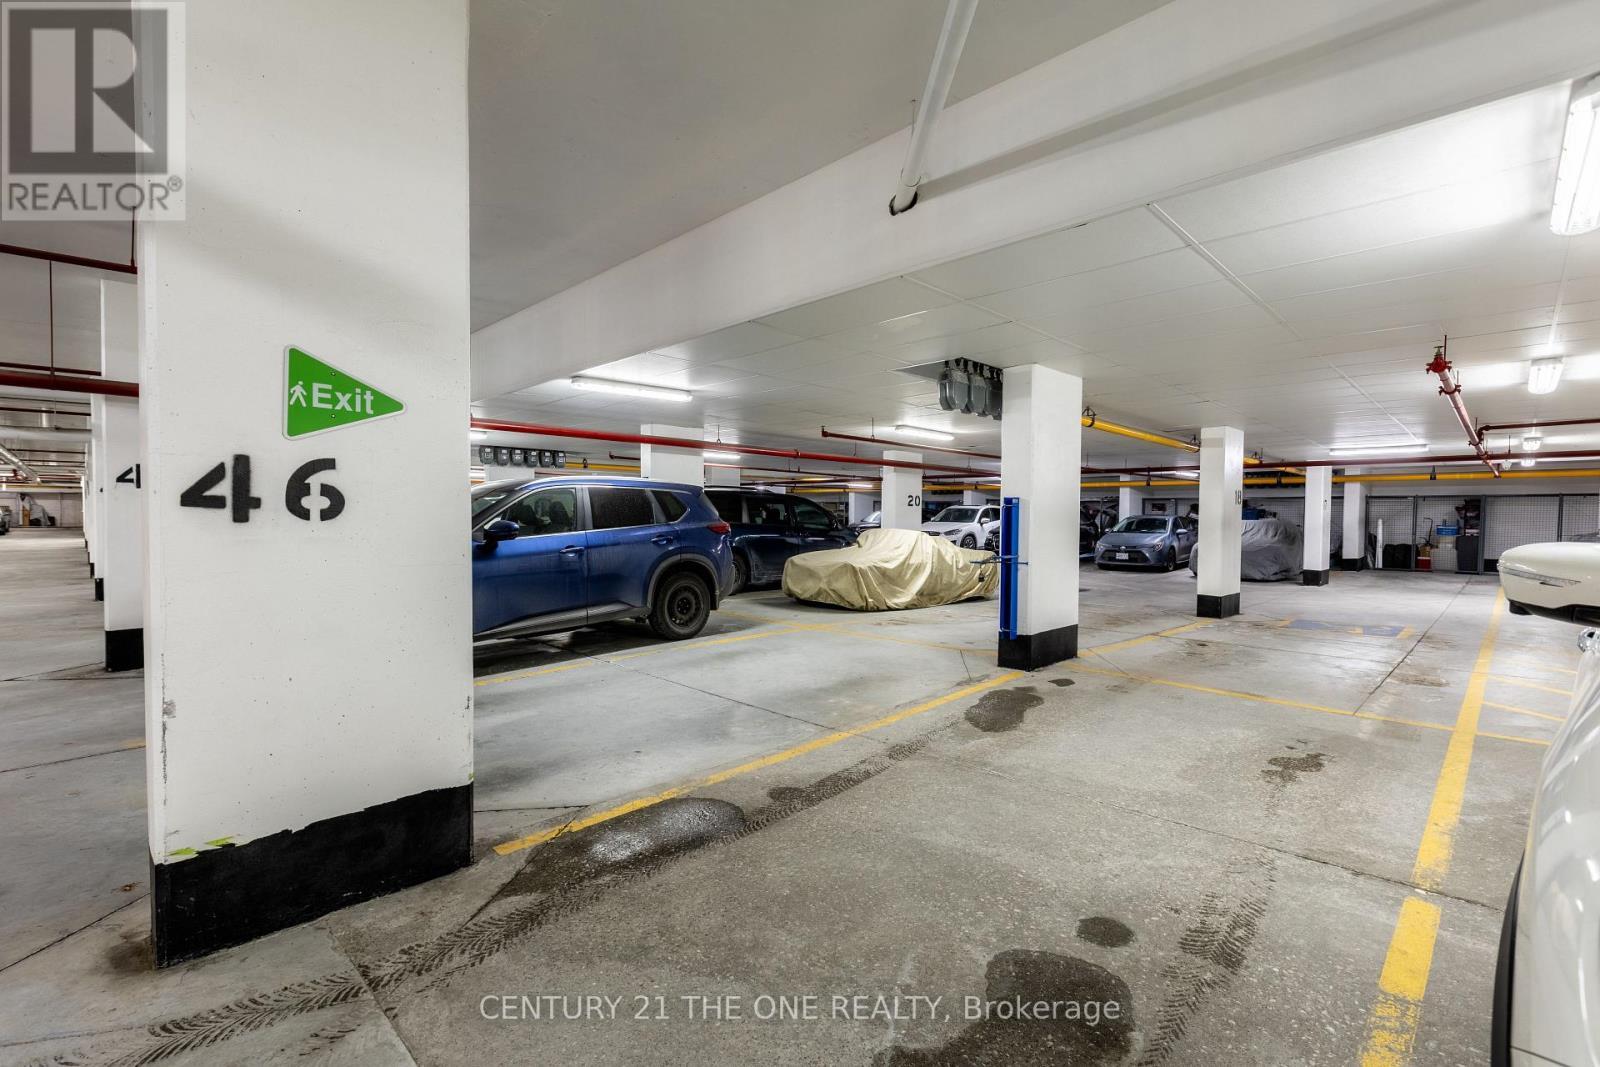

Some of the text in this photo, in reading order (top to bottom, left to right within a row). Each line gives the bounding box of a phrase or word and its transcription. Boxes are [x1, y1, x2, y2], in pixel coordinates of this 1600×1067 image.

[311, 382, 374, 415] Exit
[180, 454, 345, 523] 46
[907, 495, 921, 507] 20
